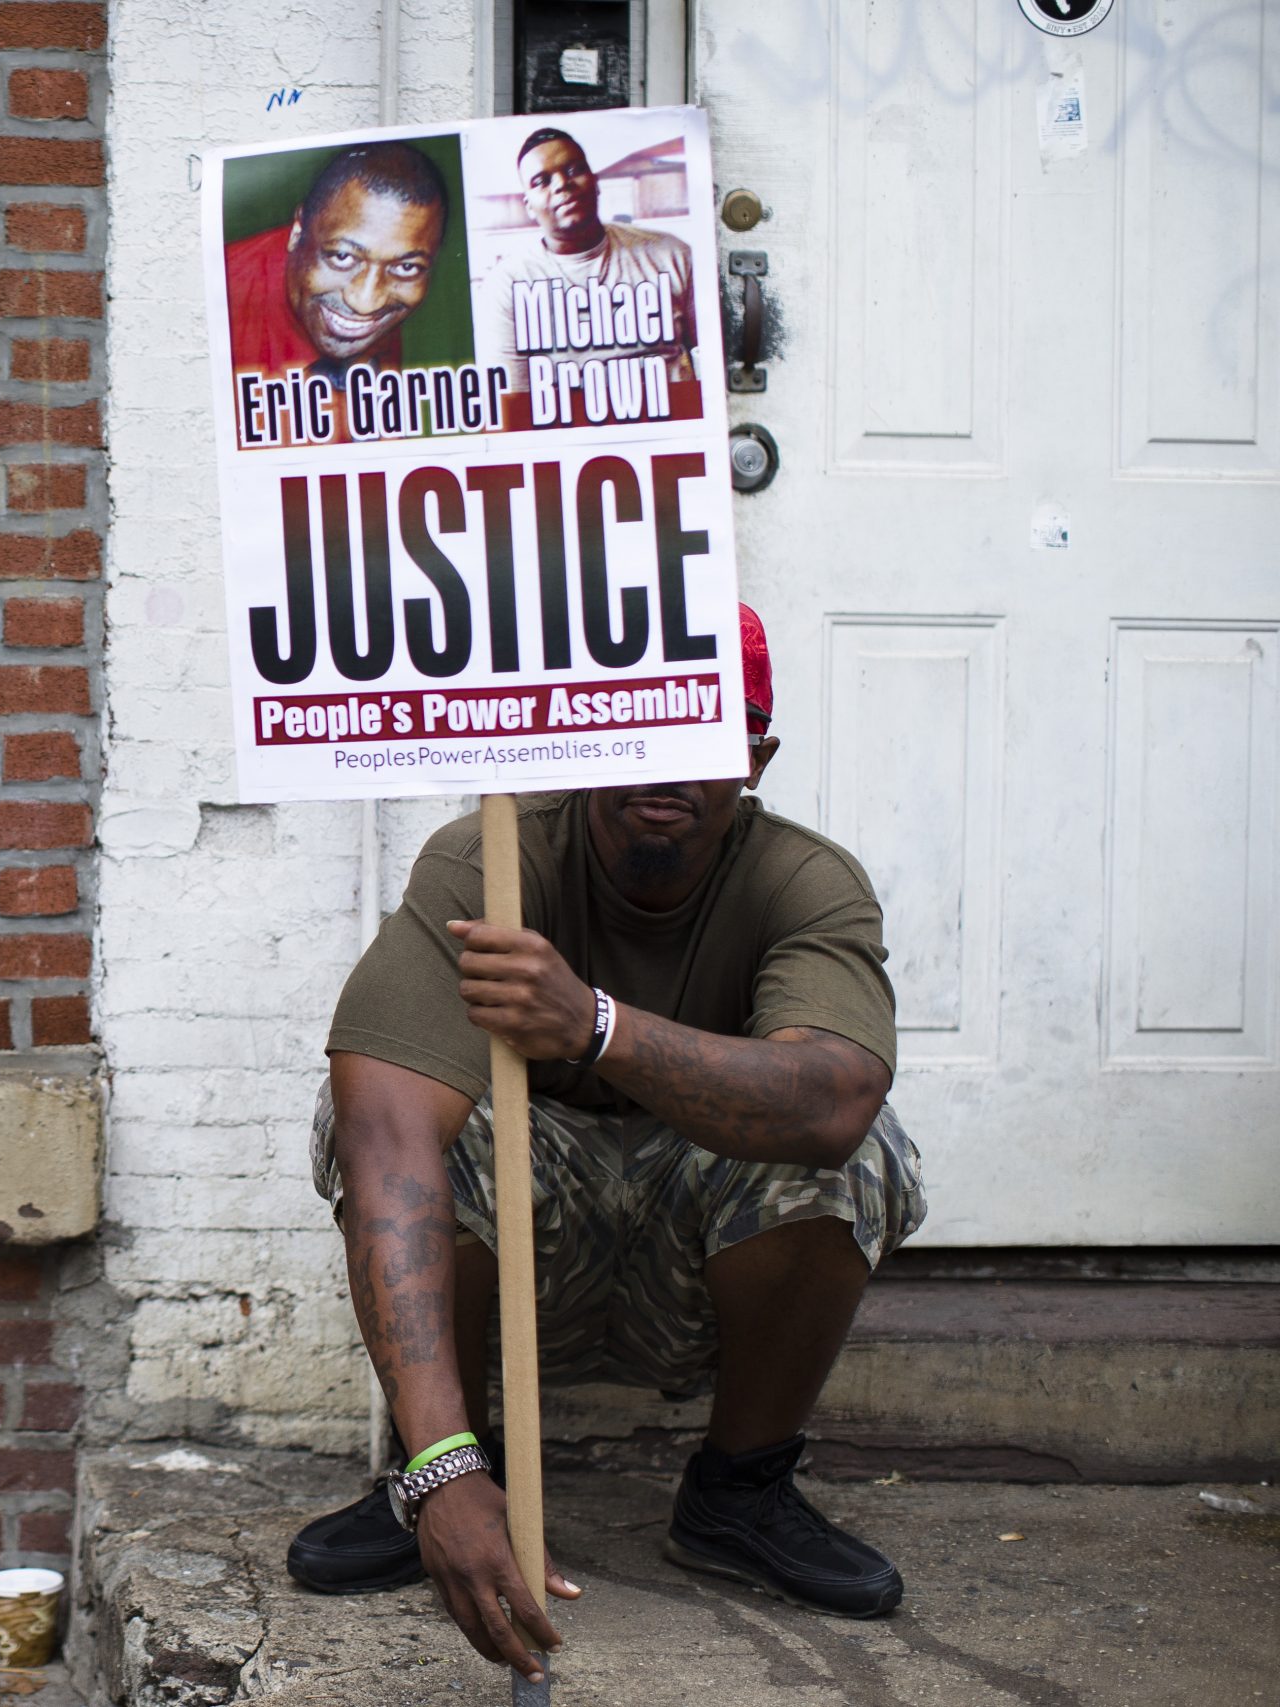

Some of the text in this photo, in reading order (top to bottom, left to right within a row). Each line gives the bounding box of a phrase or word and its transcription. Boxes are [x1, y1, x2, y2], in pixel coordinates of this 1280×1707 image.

[513, 272, 675, 352] Michael
[239, 364, 510, 446] Eric Garner
[529, 355, 671, 427] Brown
[249, 452, 718, 685] JUSTICE
[260, 679, 719, 741] People's Power Assembly
[335, 740, 646, 772] PeoplesPowerAssemblies.org
